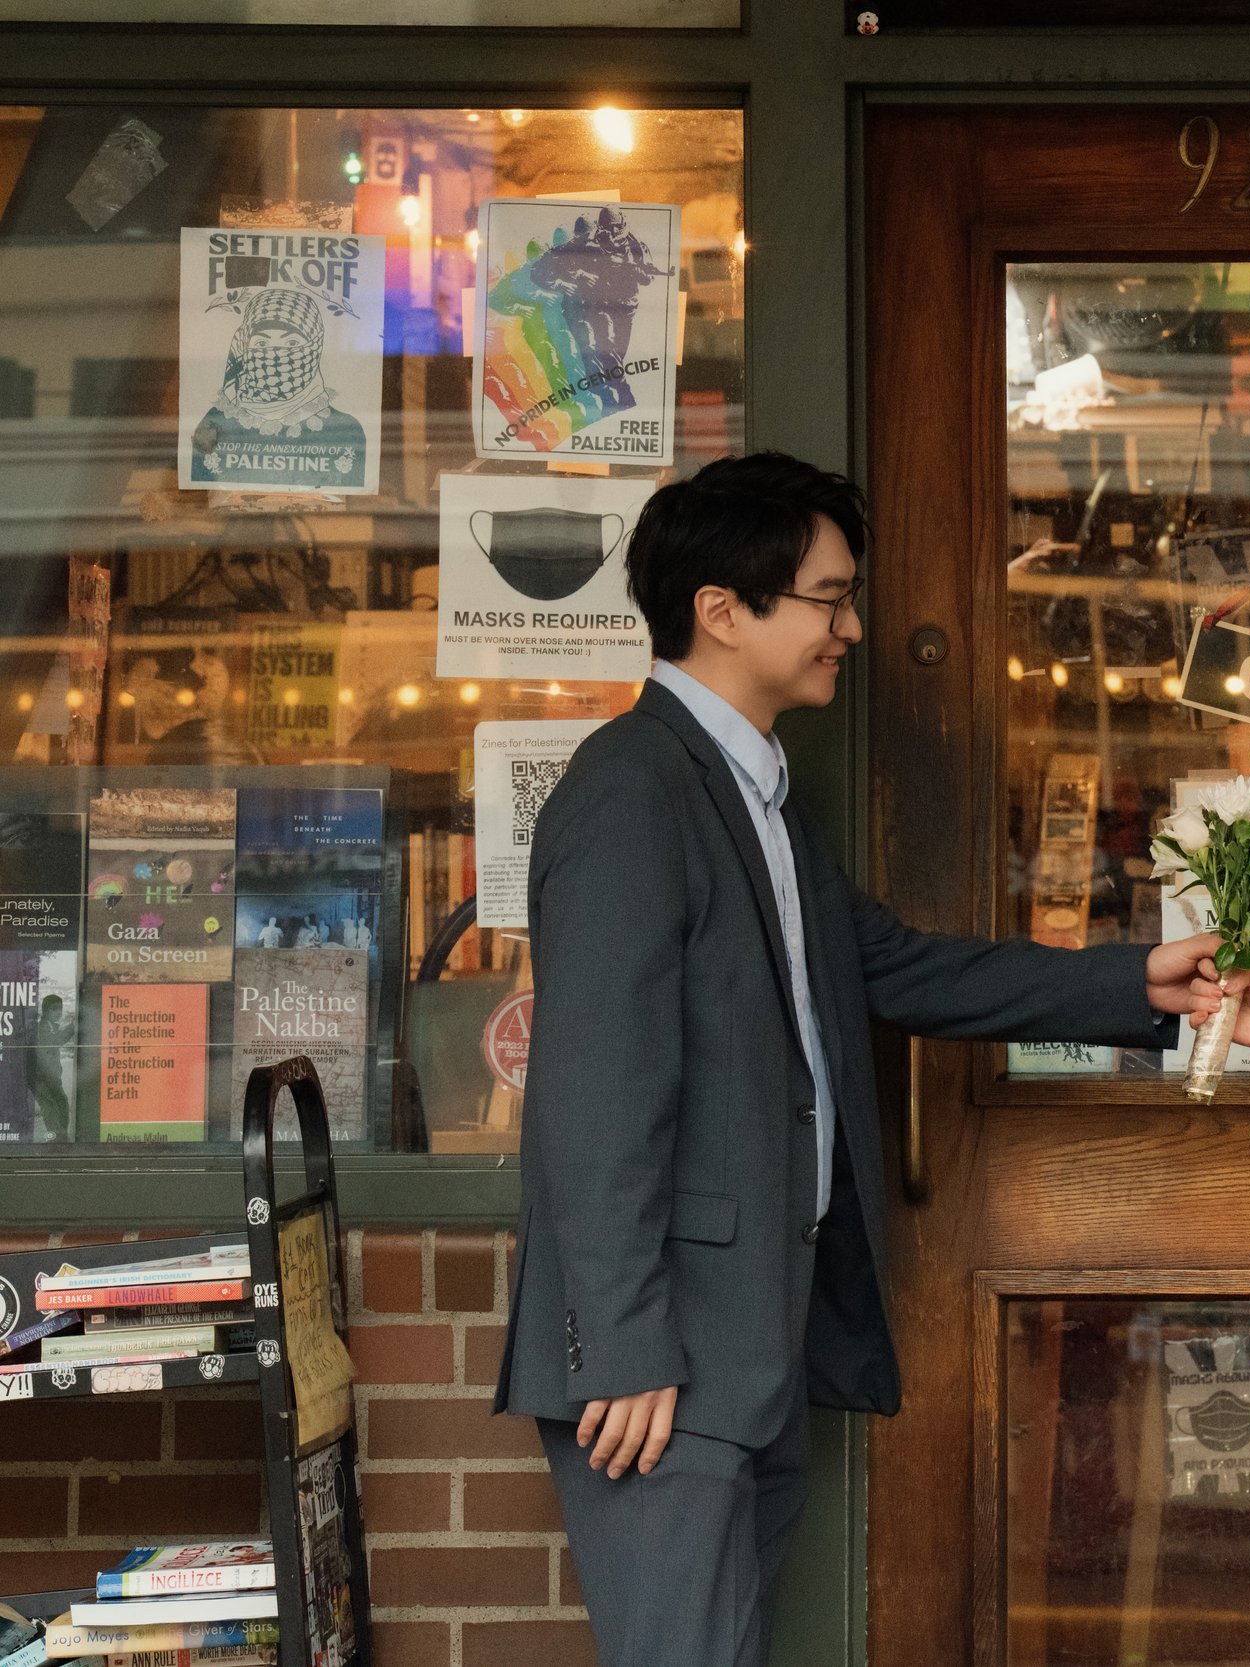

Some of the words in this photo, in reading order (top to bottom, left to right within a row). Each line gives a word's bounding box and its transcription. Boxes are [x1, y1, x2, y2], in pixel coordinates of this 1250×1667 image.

[209, 233, 360, 260] SETTLERS
[208, 256, 293, 296] FK
[301, 259, 359, 299] OFF
[494, 423, 519, 447] NO
[519, 393, 561, 426] PRIDE
[557, 383, 577, 401] IN
[577, 357, 660, 392] GENOCIDE
[620, 420, 660, 436] FREE
[216, 442, 241, 451] STOP
[242, 443, 263, 452] THE
[263, 444, 326, 454] ANNEXATION
[327, 446, 343, 455] OF
[571, 435, 659, 453] PALESTINE
[225, 453, 330, 472] PALESTINE
[454, 611, 525, 628] MASKS
[532, 613, 637, 630] REQUIRED
[444, 635, 468, 643] MUST
[470, 636, 482, 644] BE
[484, 636, 511, 644] WORN
[513, 637, 537, 645] OVER
[564, 638, 583, 646] AND
[585, 638, 616, 646] MOUTH
[618, 639, 645, 647] WHILE
[531, 647, 560, 655] THANK
[562, 648, 583, 656] YOU!
[481, 739, 507, 749] Zines
[509, 738, 522, 748] for
[525, 738, 577, 748] Palestinian
[1, 914, 69, 927] Paradise
[107, 923, 160, 940] Gaza
[107, 950, 132, 963] on
[138, 946, 208, 963] Screen
[0, 981, 36, 1007] TINE
[283, 981, 308, 994] The
[108, 996, 130, 1008] The
[240, 987, 356, 1012] Palestine
[108, 1011, 176, 1024] Destruction
[255, 1012, 340, 1037] Nakba
[108, 1026, 120, 1038] of
[122, 1026, 175, 1039] Palestine
[109, 1042, 119, 1054] is
[121, 1041, 141, 1054] the
[497, 1041, 524, 1049] 2022
[107, 1057, 175, 1069] Destruction
[107, 1072, 120, 1084] of
[121, 1072, 141, 1084] the
[106, 1087, 139, 1100] Earth
[106, 1133, 141, 1143] Andreas
[143, 1132, 168, 1143] Malm
[69, 1277, 117, 1287] BEGINNER'S
[119, 1275, 141, 1284] IRISH
[143, 1272, 192, 1281] DICTIONARY
[48, 1295, 63, 1305] JES
[65, 1294, 93, 1304] BAKER
[108, 1286, 174, 1305] LANDWHALE
[254, 1283, 278, 1297] OYE
[254, 1296, 279, 1308] RUNS
[144, 1317, 152, 1326] IN
[152, 1316, 163, 1325] THE
[164, 1315, 193, 1324] PRESENCE
[1171, 1373, 1213, 1386] MASKS
[150, 1570, 223, 1591] İNGİLİZCE
[52, 1636, 81, 1647] Jojo
[86, 1630, 130, 1644] Moyes
[189, 1624, 224, 1637] Giver
[227, 1622, 238, 1636] of
[242, 1620, 272, 1633] Stars
[131, 1651, 151, 1667] ANN
[154, 1650, 176, 1667] RULE
[198, 1647, 220, 1660] WORTH
[220, 1645, 239, 1658] MORE
[239, 1644, 257, 1655] DEAD
